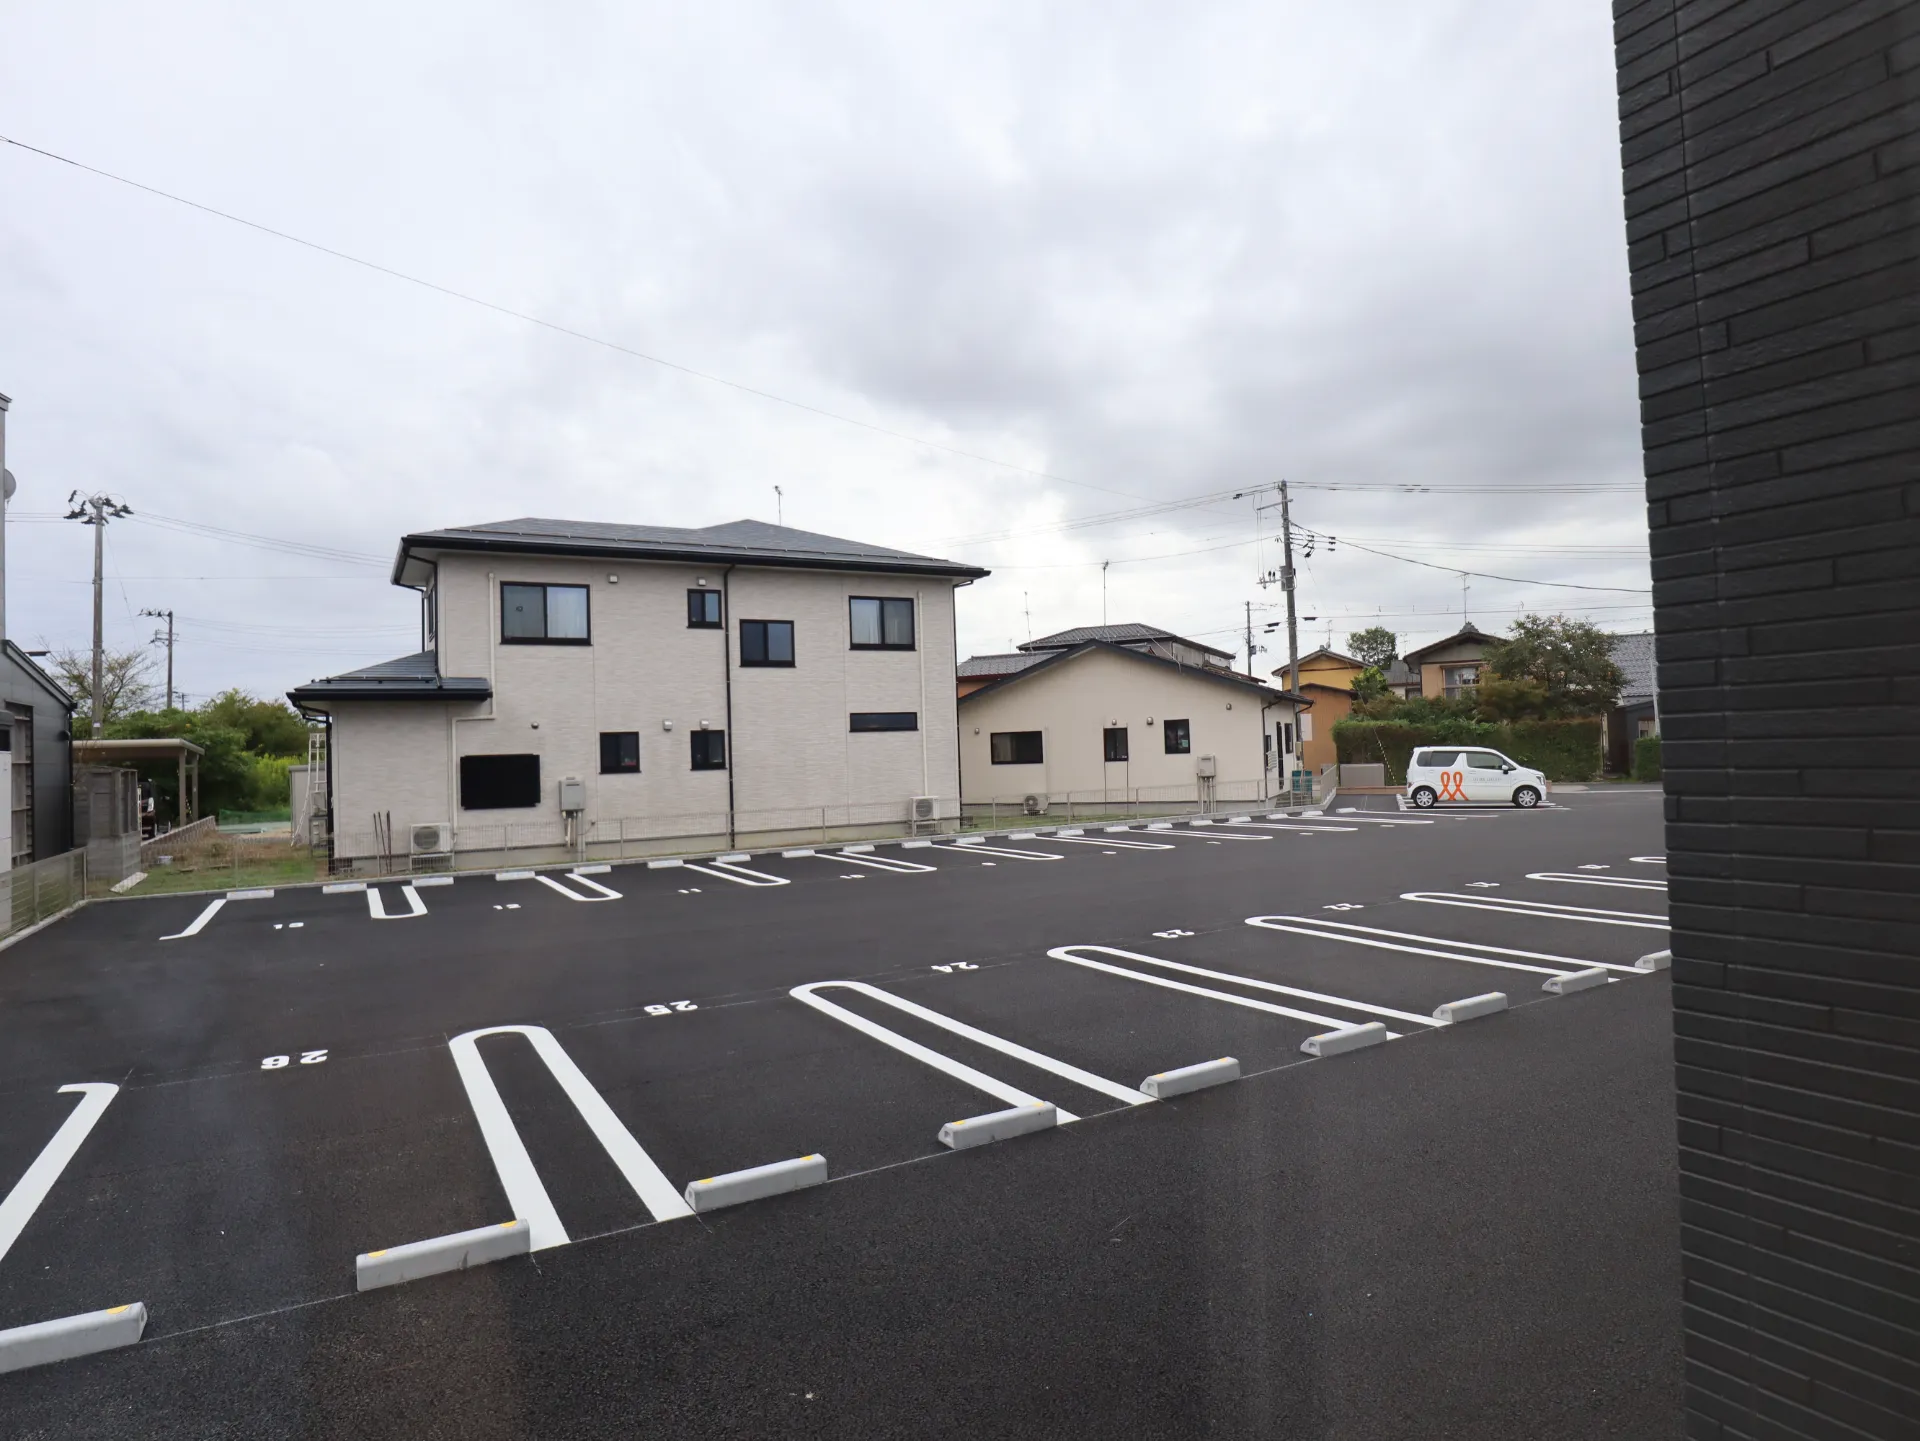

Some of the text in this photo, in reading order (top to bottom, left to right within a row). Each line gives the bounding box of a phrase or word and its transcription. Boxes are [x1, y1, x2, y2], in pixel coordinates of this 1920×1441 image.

[930, 961, 980, 973] 24
[643, 1000, 698, 1016] 25
[260, 1049, 329, 1070] 26
